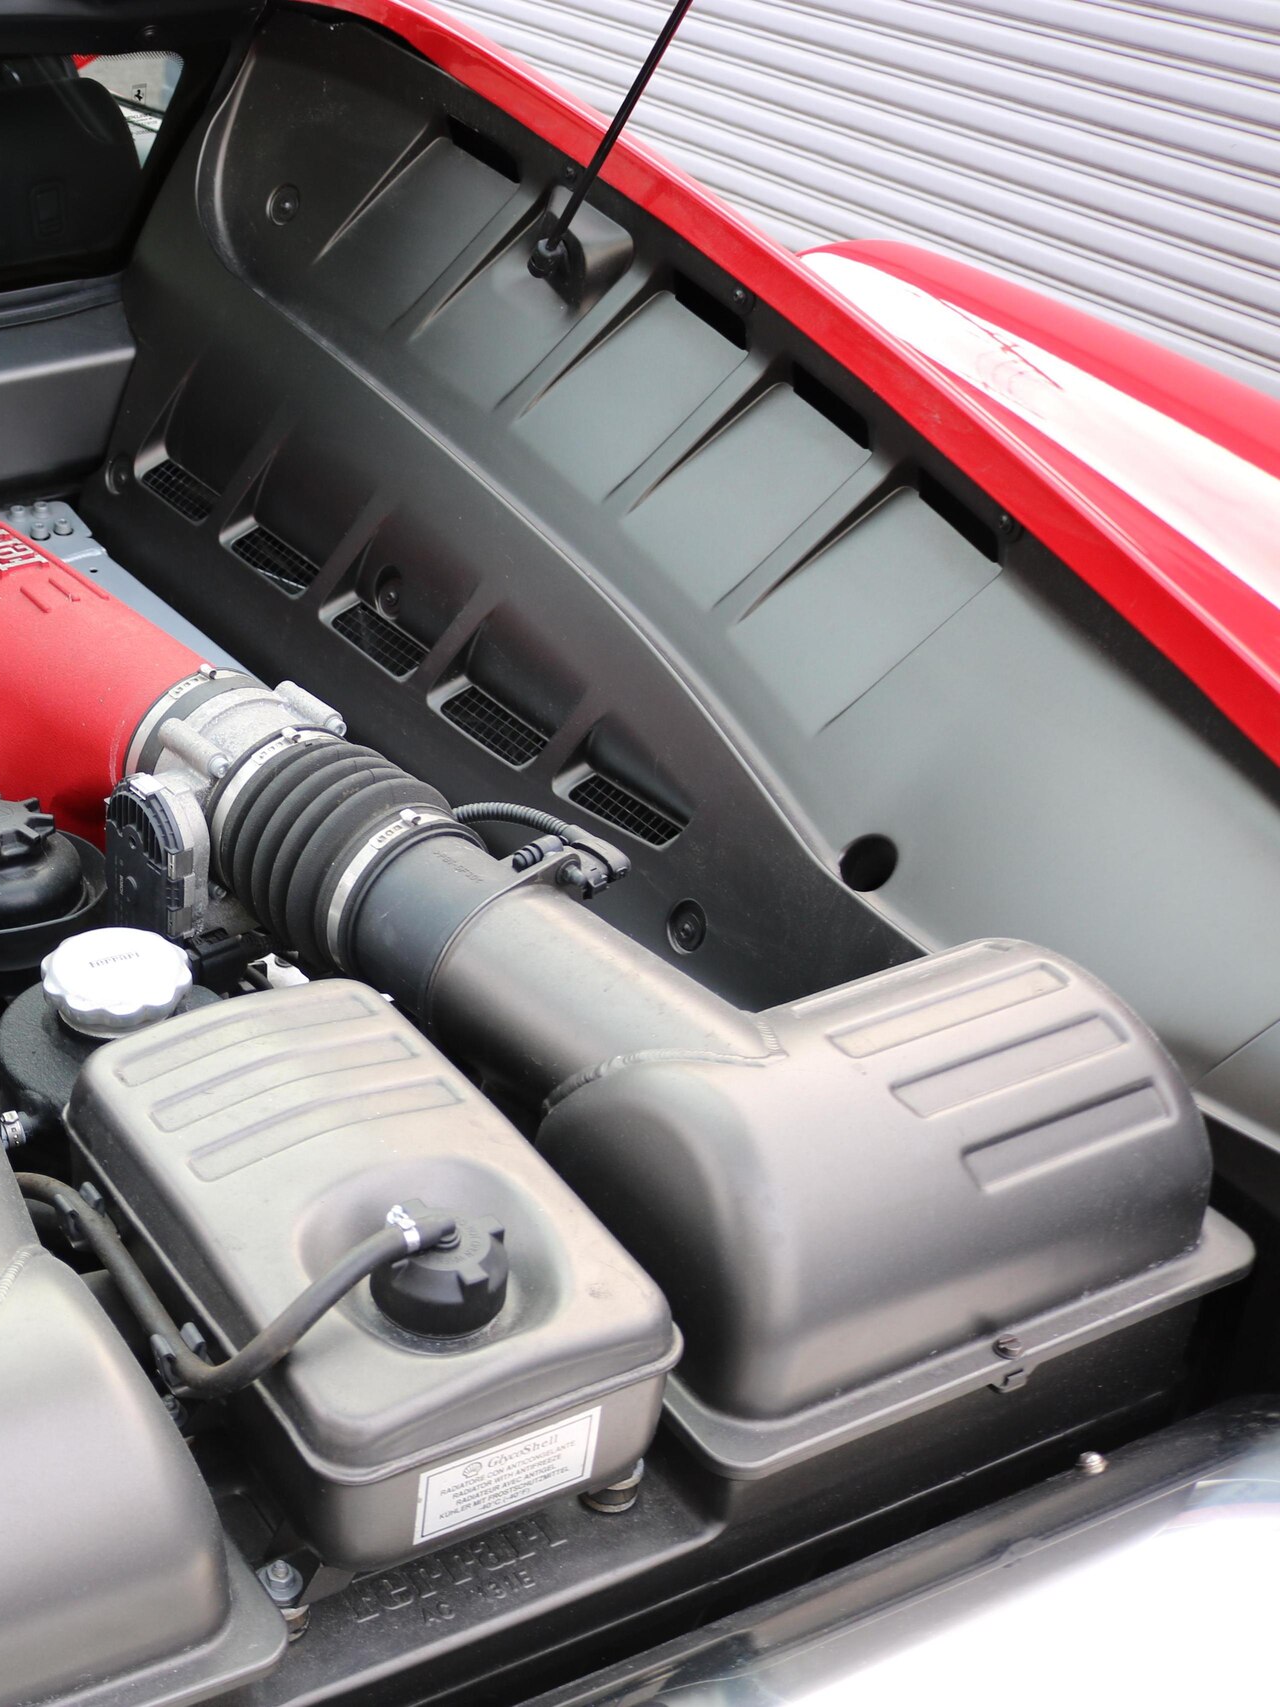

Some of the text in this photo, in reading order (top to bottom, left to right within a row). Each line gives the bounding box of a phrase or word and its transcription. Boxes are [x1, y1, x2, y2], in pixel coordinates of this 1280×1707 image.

[440, 1439, 575, 1496] RADIATORE CON ANTICONGELANTE
[489, 1433, 557, 1470] GlycoShell
[452, 1453, 560, 1499] RADIATOR WITH ANTIFREEZE
[455, 1463, 555, 1505] RADIATEUR AVEC ANTIGEL
[472, 1496, 486, 1506] MIT
